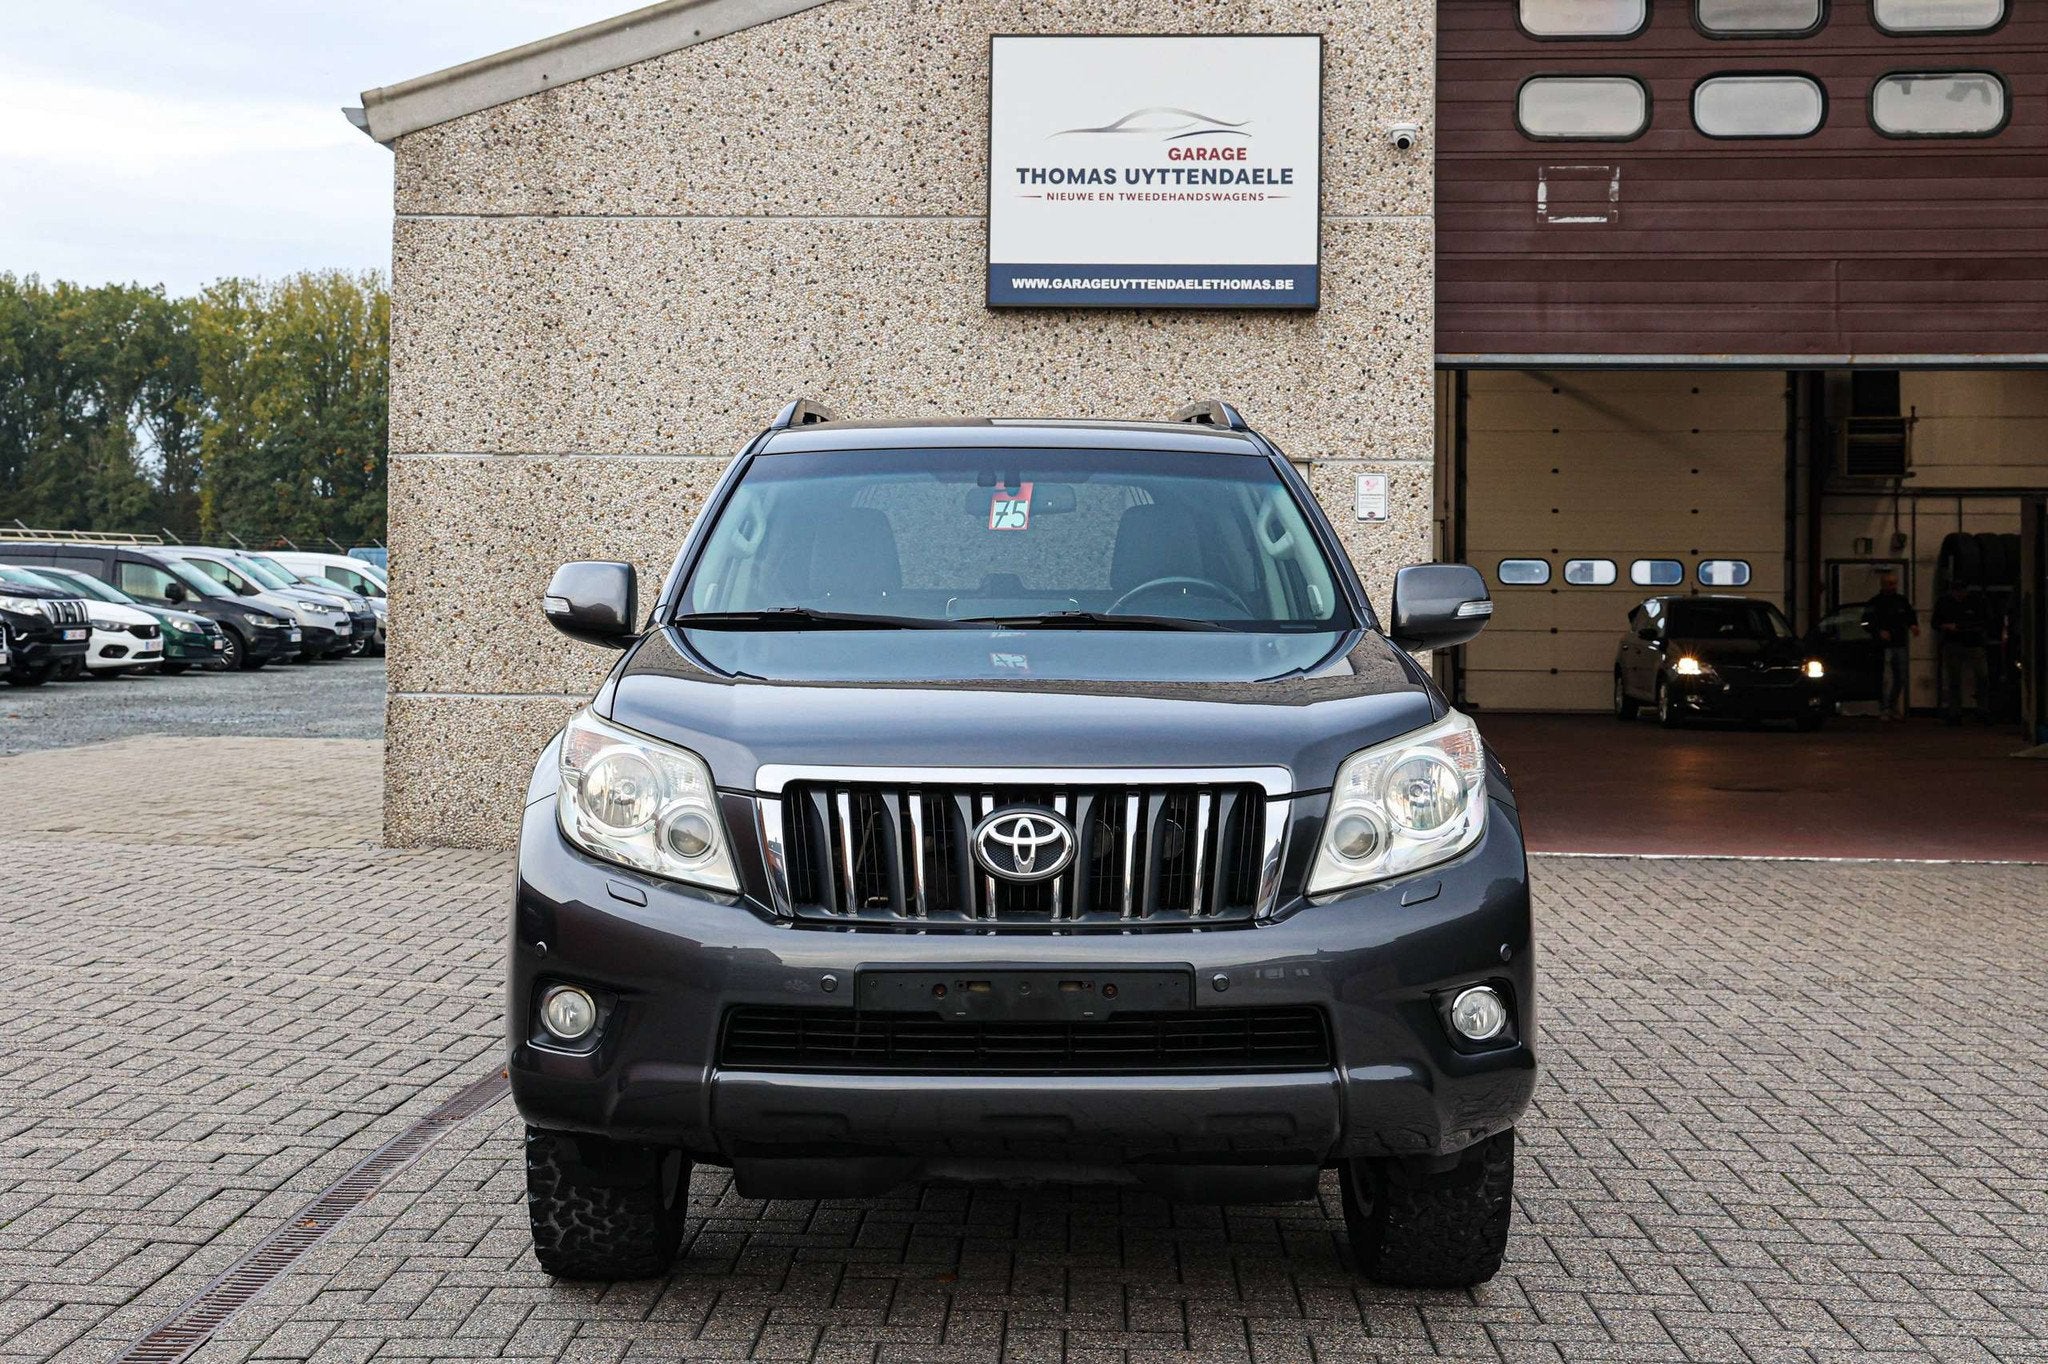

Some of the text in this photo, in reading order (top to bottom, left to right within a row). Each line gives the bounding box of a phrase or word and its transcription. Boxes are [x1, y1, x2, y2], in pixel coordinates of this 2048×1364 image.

[1168, 147, 1247, 161] GARAGE
[1016, 167, 1293, 185] THOMAS UYTTENDAELE
[1046, 192, 1265, 202] NIEUWE EN TWEEDEHANDSWAGENS
[1012, 278, 1294, 290] WWW.GARAGEUYTTENDAELETHOMAS.BE
[995, 500, 1026, 528] 75
